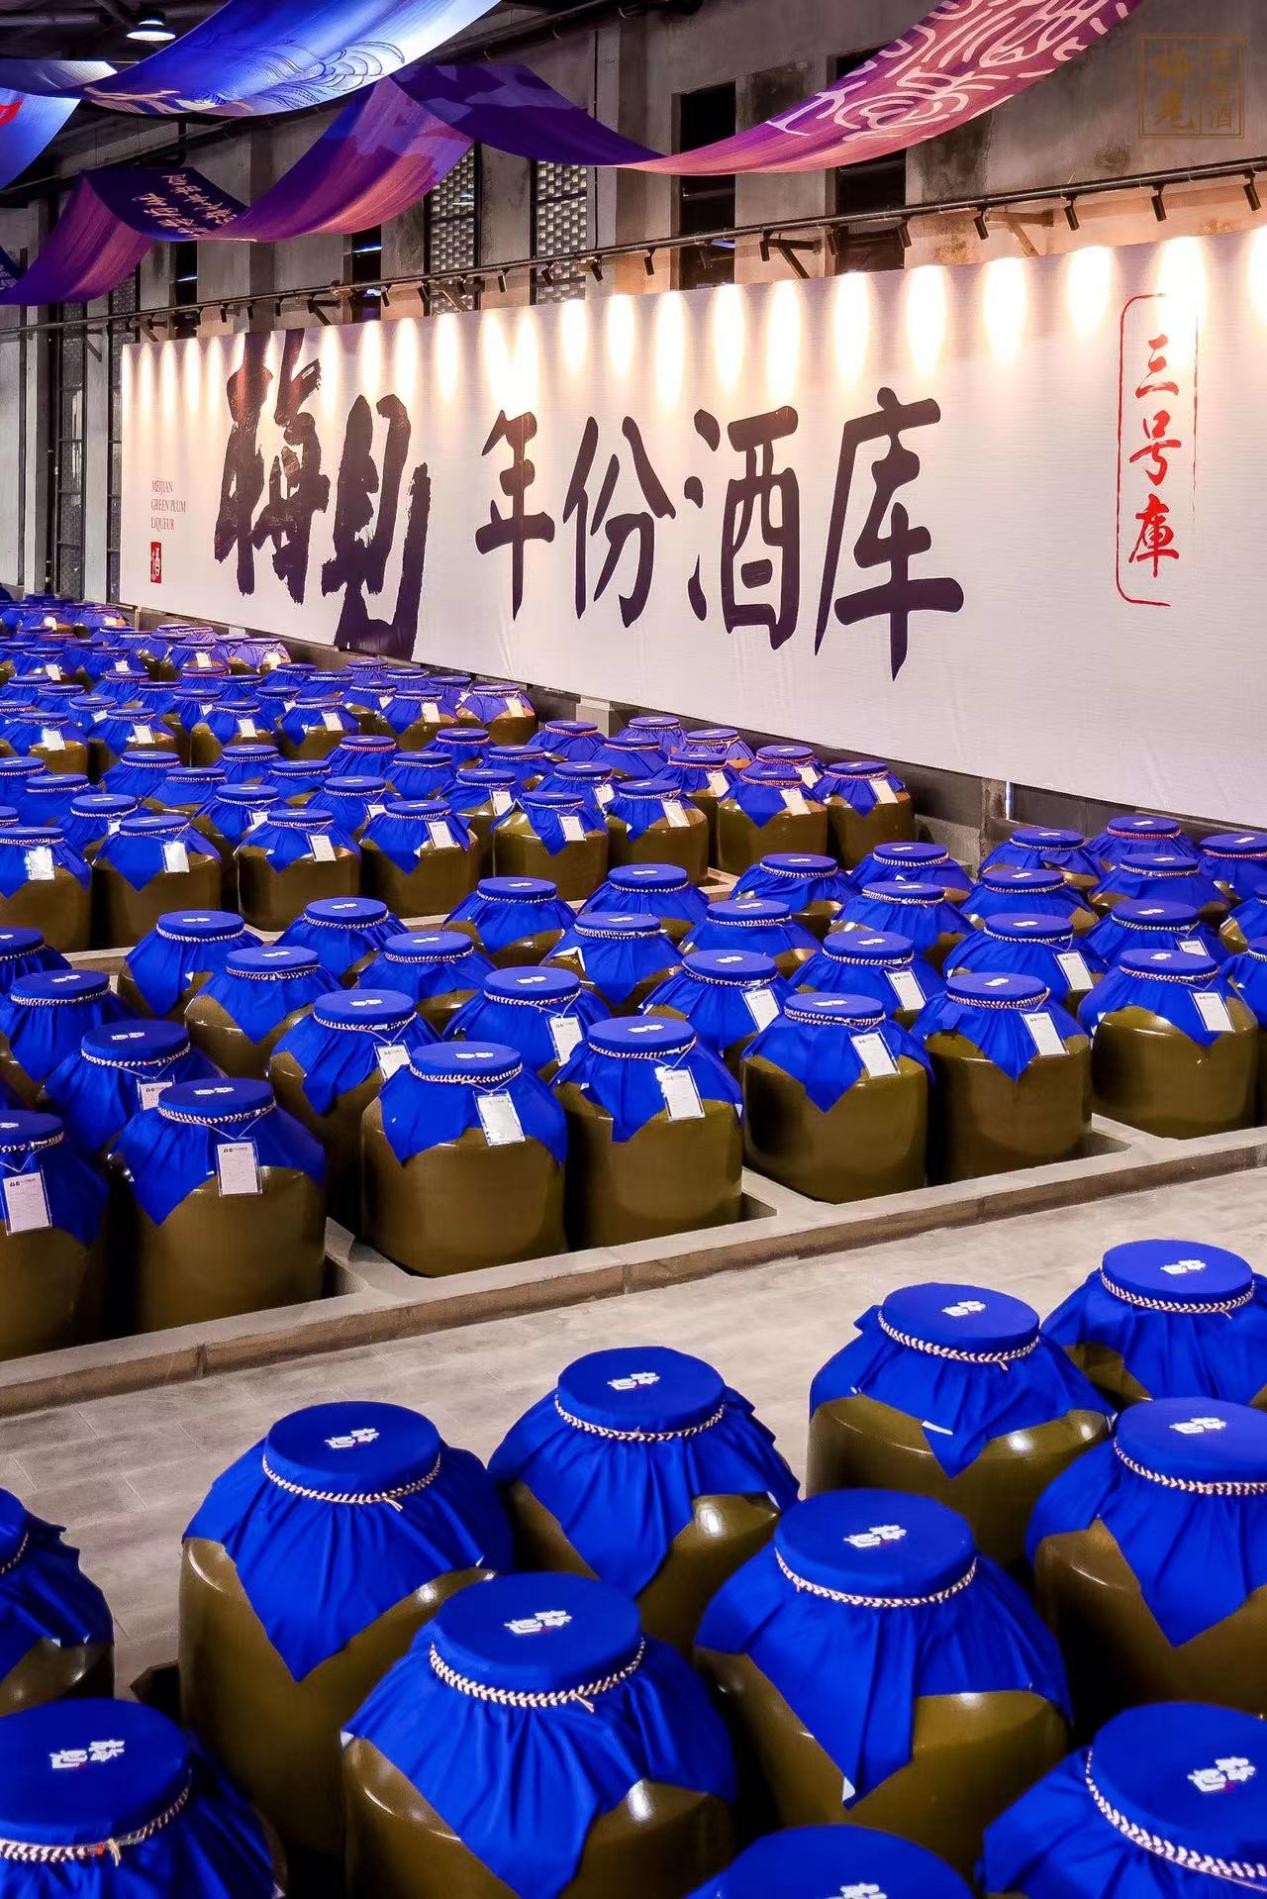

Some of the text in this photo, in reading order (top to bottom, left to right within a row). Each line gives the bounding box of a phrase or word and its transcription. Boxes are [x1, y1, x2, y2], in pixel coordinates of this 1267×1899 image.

[150, 498, 186, 513] GREEN PLUM
[474, 386, 965, 681] 年份酒库
